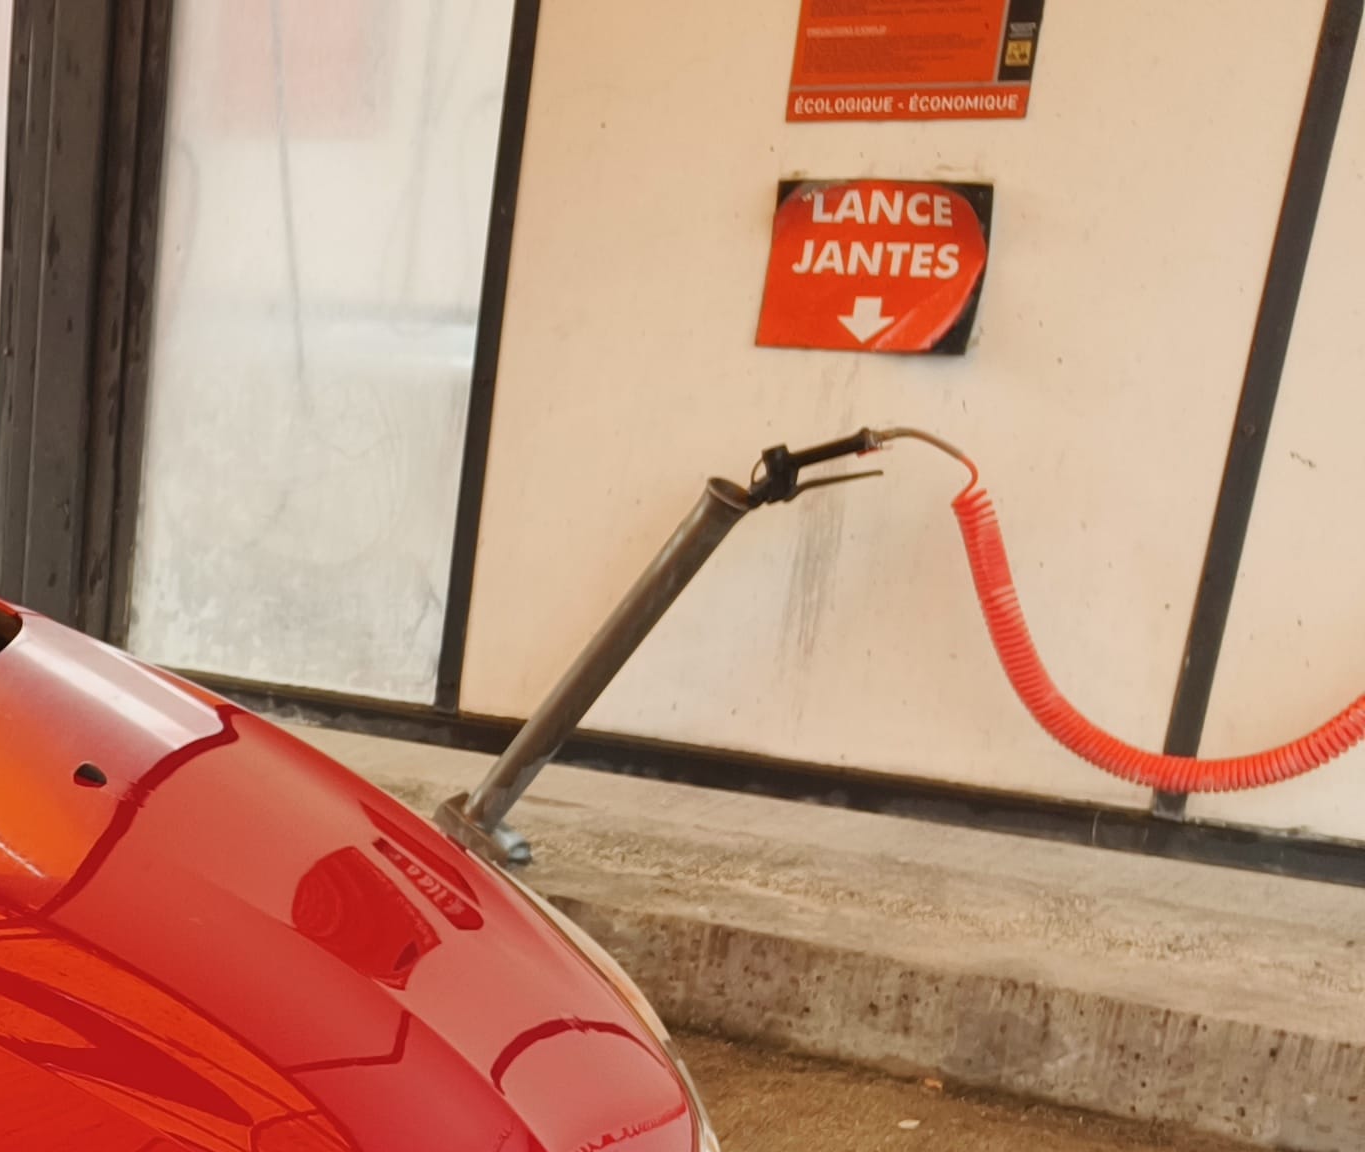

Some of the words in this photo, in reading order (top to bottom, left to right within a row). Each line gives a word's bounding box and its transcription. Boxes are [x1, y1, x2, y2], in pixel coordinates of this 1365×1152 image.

[794, 95, 894, 114] ÉCOLOGIQUE
[908, 92, 1019, 113] ÉCONOMIQUE
[811, 188, 953, 228] LANCE
[791, 239, 960, 280] JANTES
